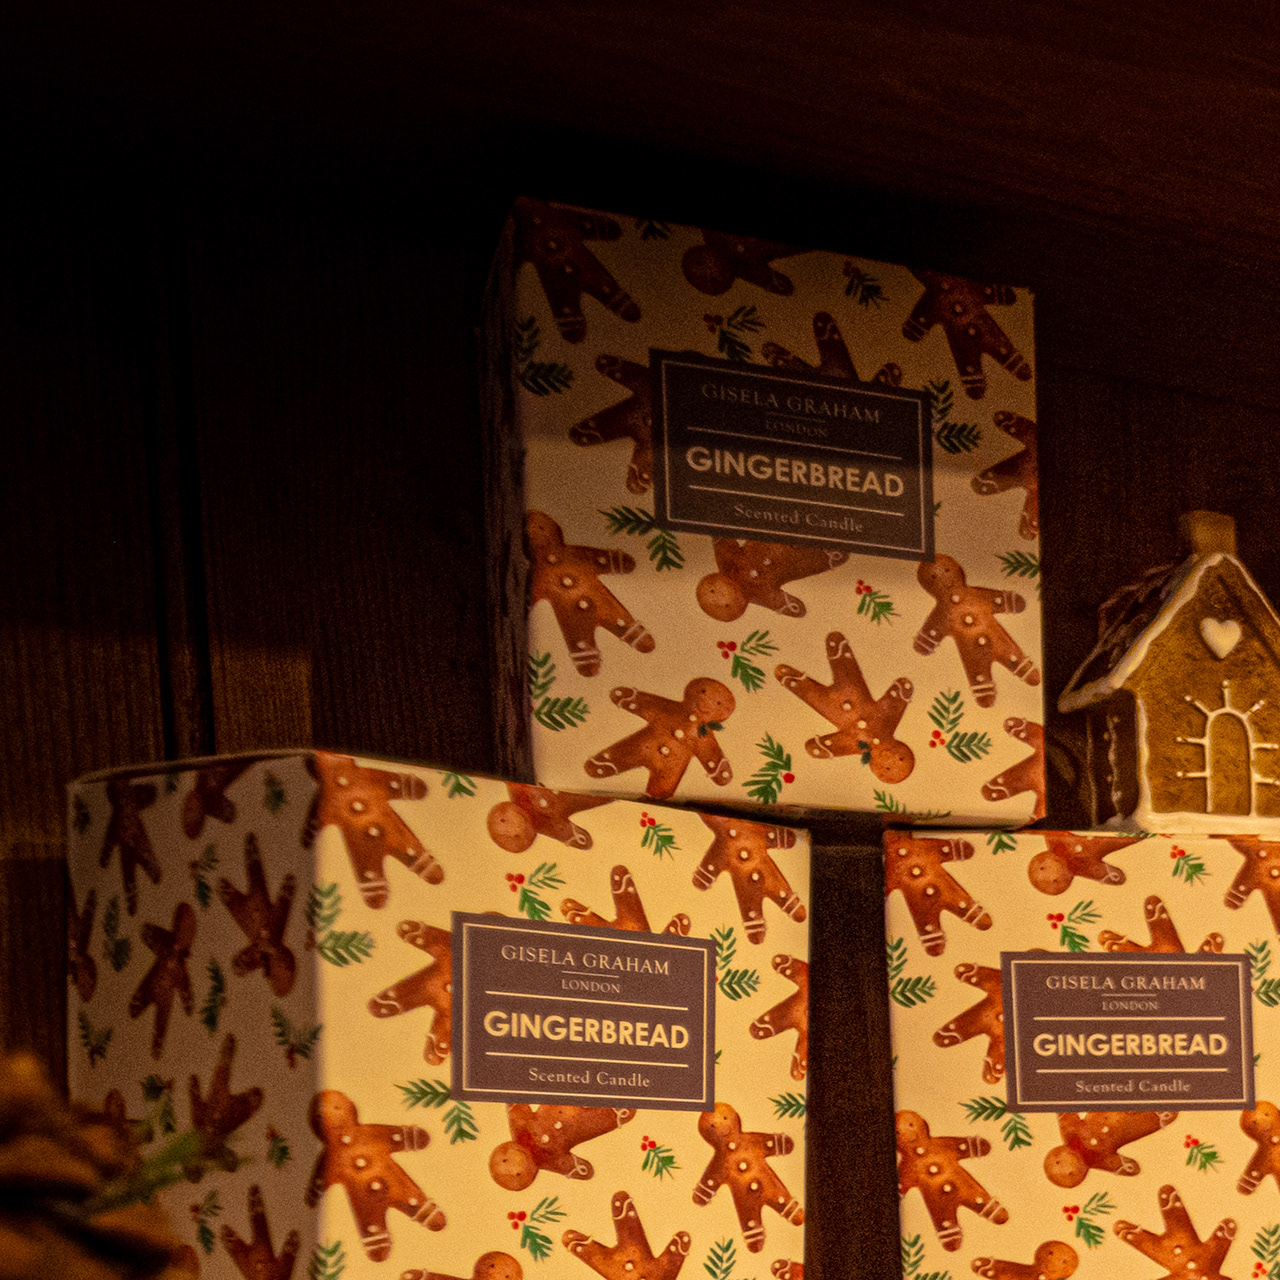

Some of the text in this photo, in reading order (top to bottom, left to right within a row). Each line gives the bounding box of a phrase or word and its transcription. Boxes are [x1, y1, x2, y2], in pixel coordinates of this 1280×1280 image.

[701, 383, 881, 424] GISELA GRAHAM
[765, 419, 828, 438] LONDON
[685, 446, 904, 497] GINGERBREAD
[734, 503, 864, 533] Scented Candle
[501, 944, 669, 976] GISELA GRAHAM
[561, 979, 622, 994] LONDON
[1045, 975, 1207, 991] GISELA GRAHAM
[1101, 1000, 1159, 1012] LONDON
[483, 1010, 690, 1049] GINGERBREAD
[1032, 1032, 1229, 1057] GINGERBREAD
[528, 1067, 650, 1088] Scented Candle
[1075, 1078, 1191, 1094] Scented Candle
